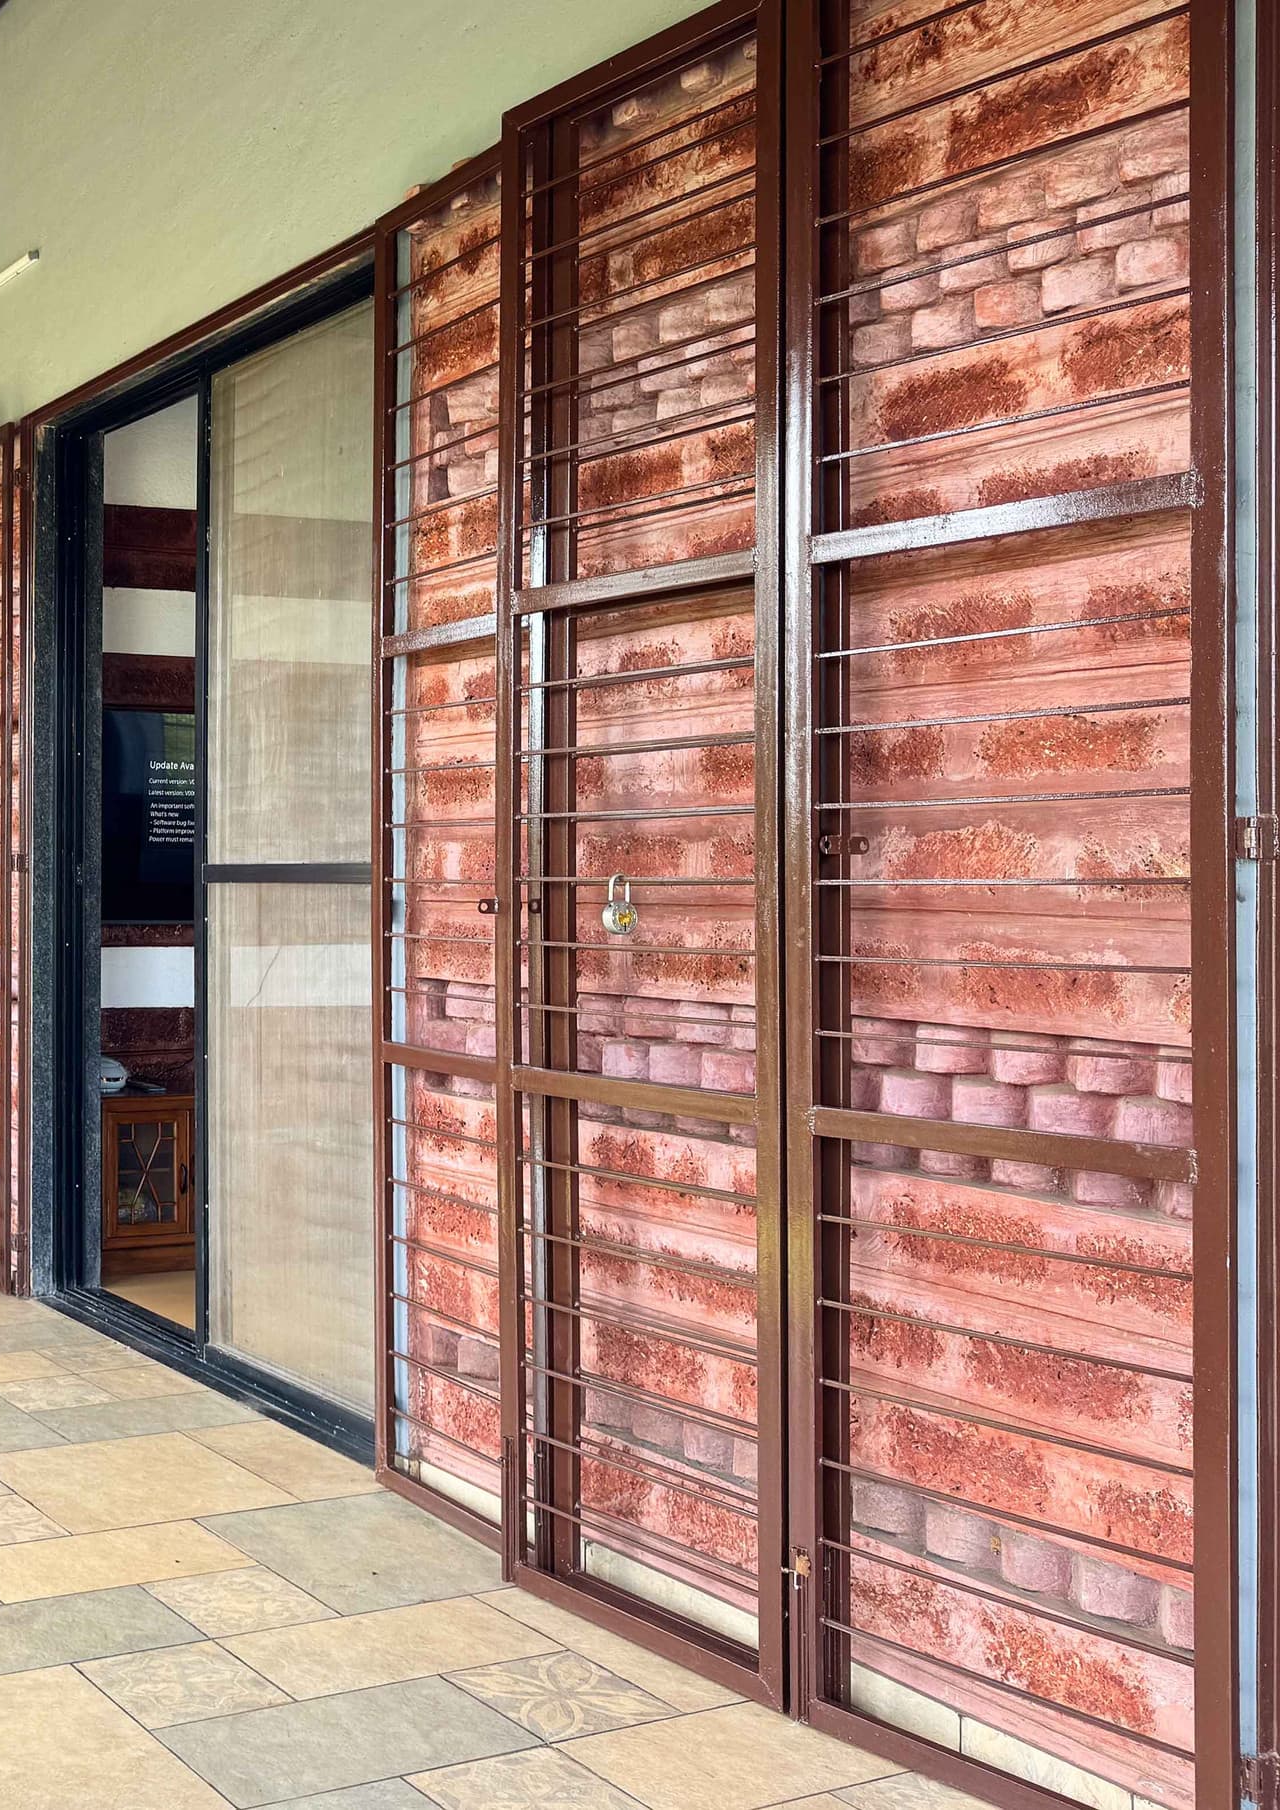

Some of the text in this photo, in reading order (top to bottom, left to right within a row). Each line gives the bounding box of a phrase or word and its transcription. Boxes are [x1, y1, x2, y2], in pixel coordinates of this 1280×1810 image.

[149, 761, 179, 770] Update
[153, 818, 176, 826] Software
[176, 819, 187, 828] bug
